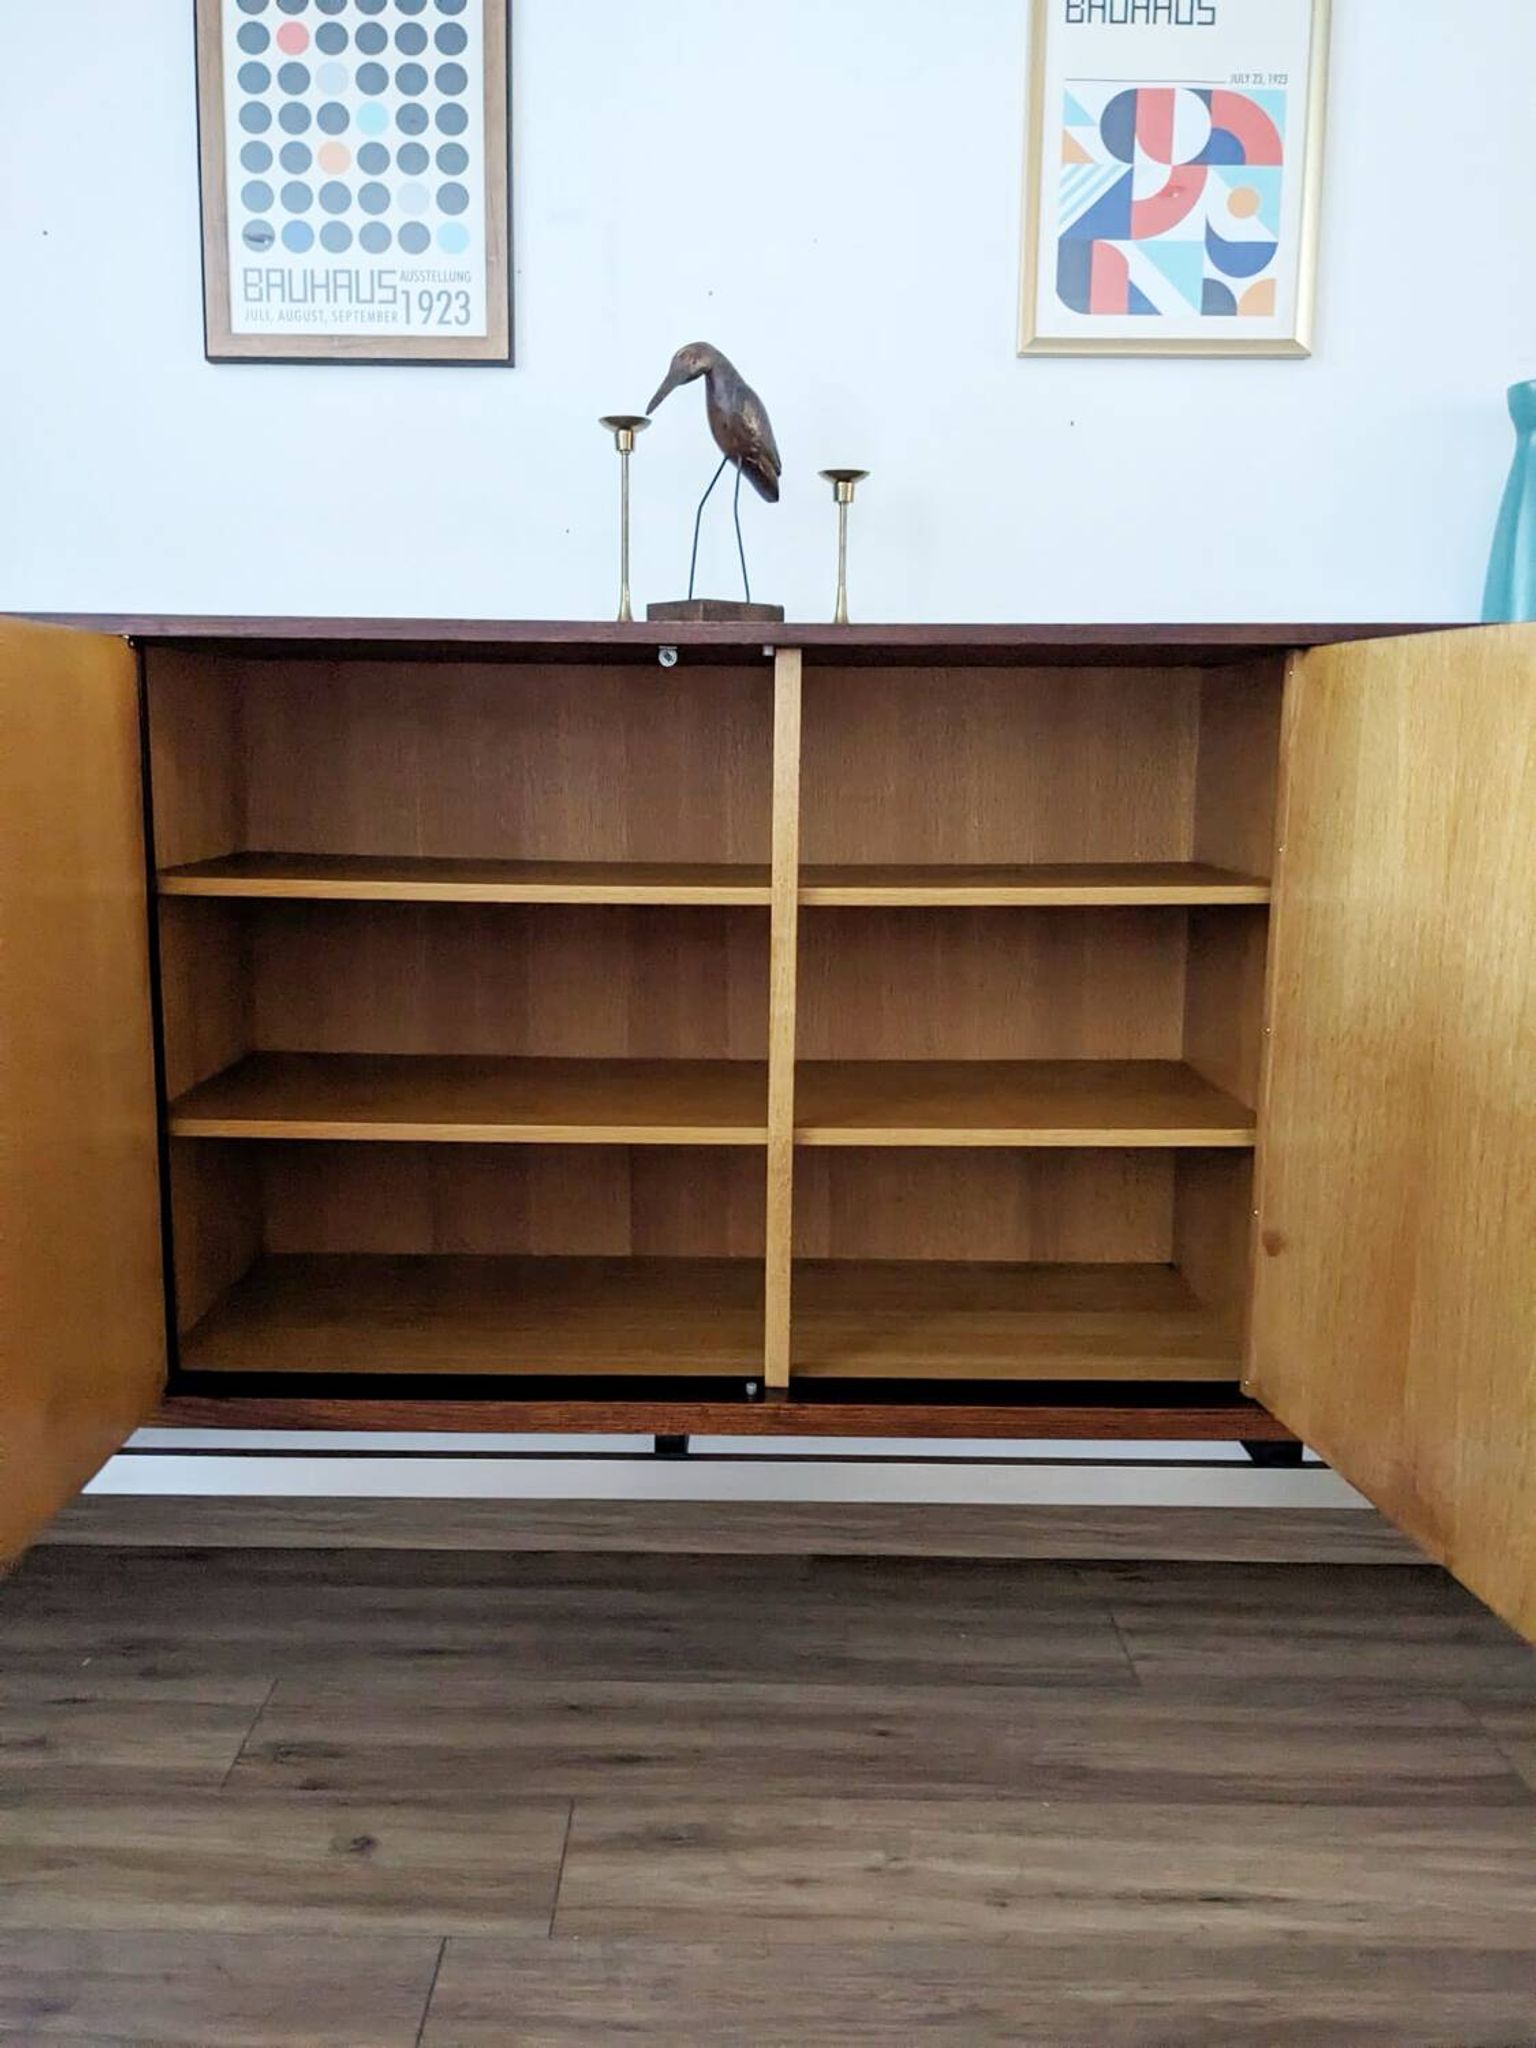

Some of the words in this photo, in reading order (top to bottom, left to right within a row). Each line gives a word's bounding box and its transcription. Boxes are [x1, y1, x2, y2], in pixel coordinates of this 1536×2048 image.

[1065, 0, 1215, 25] BAUHAUS
[1230, 73, 1250, 84] JULY
[1268, 73, 1288, 85] 1923
[243, 267, 398, 304] BAUHAUS
[399, 269, 472, 283] AUSSTELLUNG
[278, 309, 328, 326] AUGUST,
[331, 309, 399, 324] SEPTEMBER
[401, 289, 471, 326] 1923
